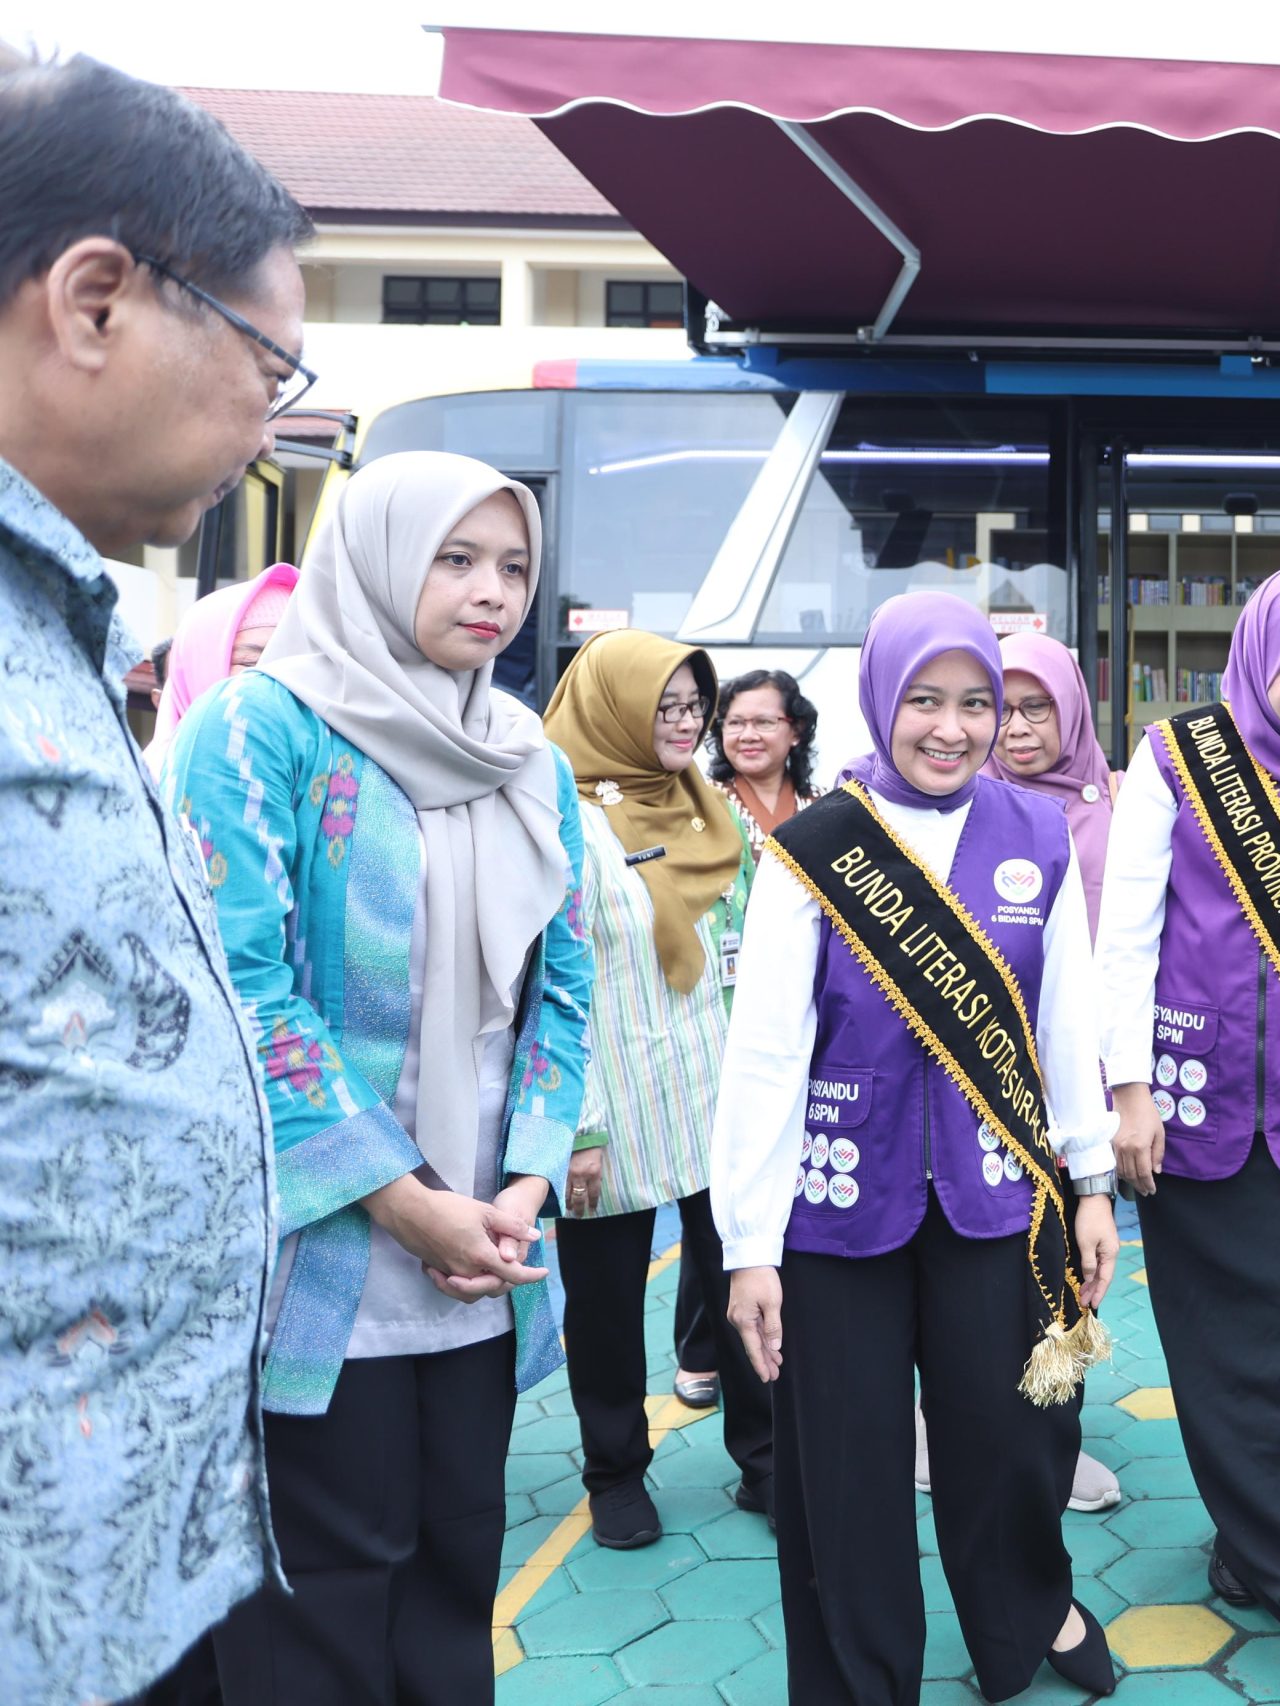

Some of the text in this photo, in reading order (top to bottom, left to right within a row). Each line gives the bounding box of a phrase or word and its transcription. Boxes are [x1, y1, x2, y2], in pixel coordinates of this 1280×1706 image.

[1187, 715, 1232, 771] BUNDA
[1210, 764, 1263, 836] LITERASI
[991, 914, 1044, 926] 6 BIDANG SPM
[997, 905, 1040, 916] POSYANDU
[830, 845, 914, 937] BUNDA
[899, 923, 993, 1029] LITERASI
[1156, 1024, 1184, 1045] SPM
[808, 1102, 839, 1124] 6 SPM
